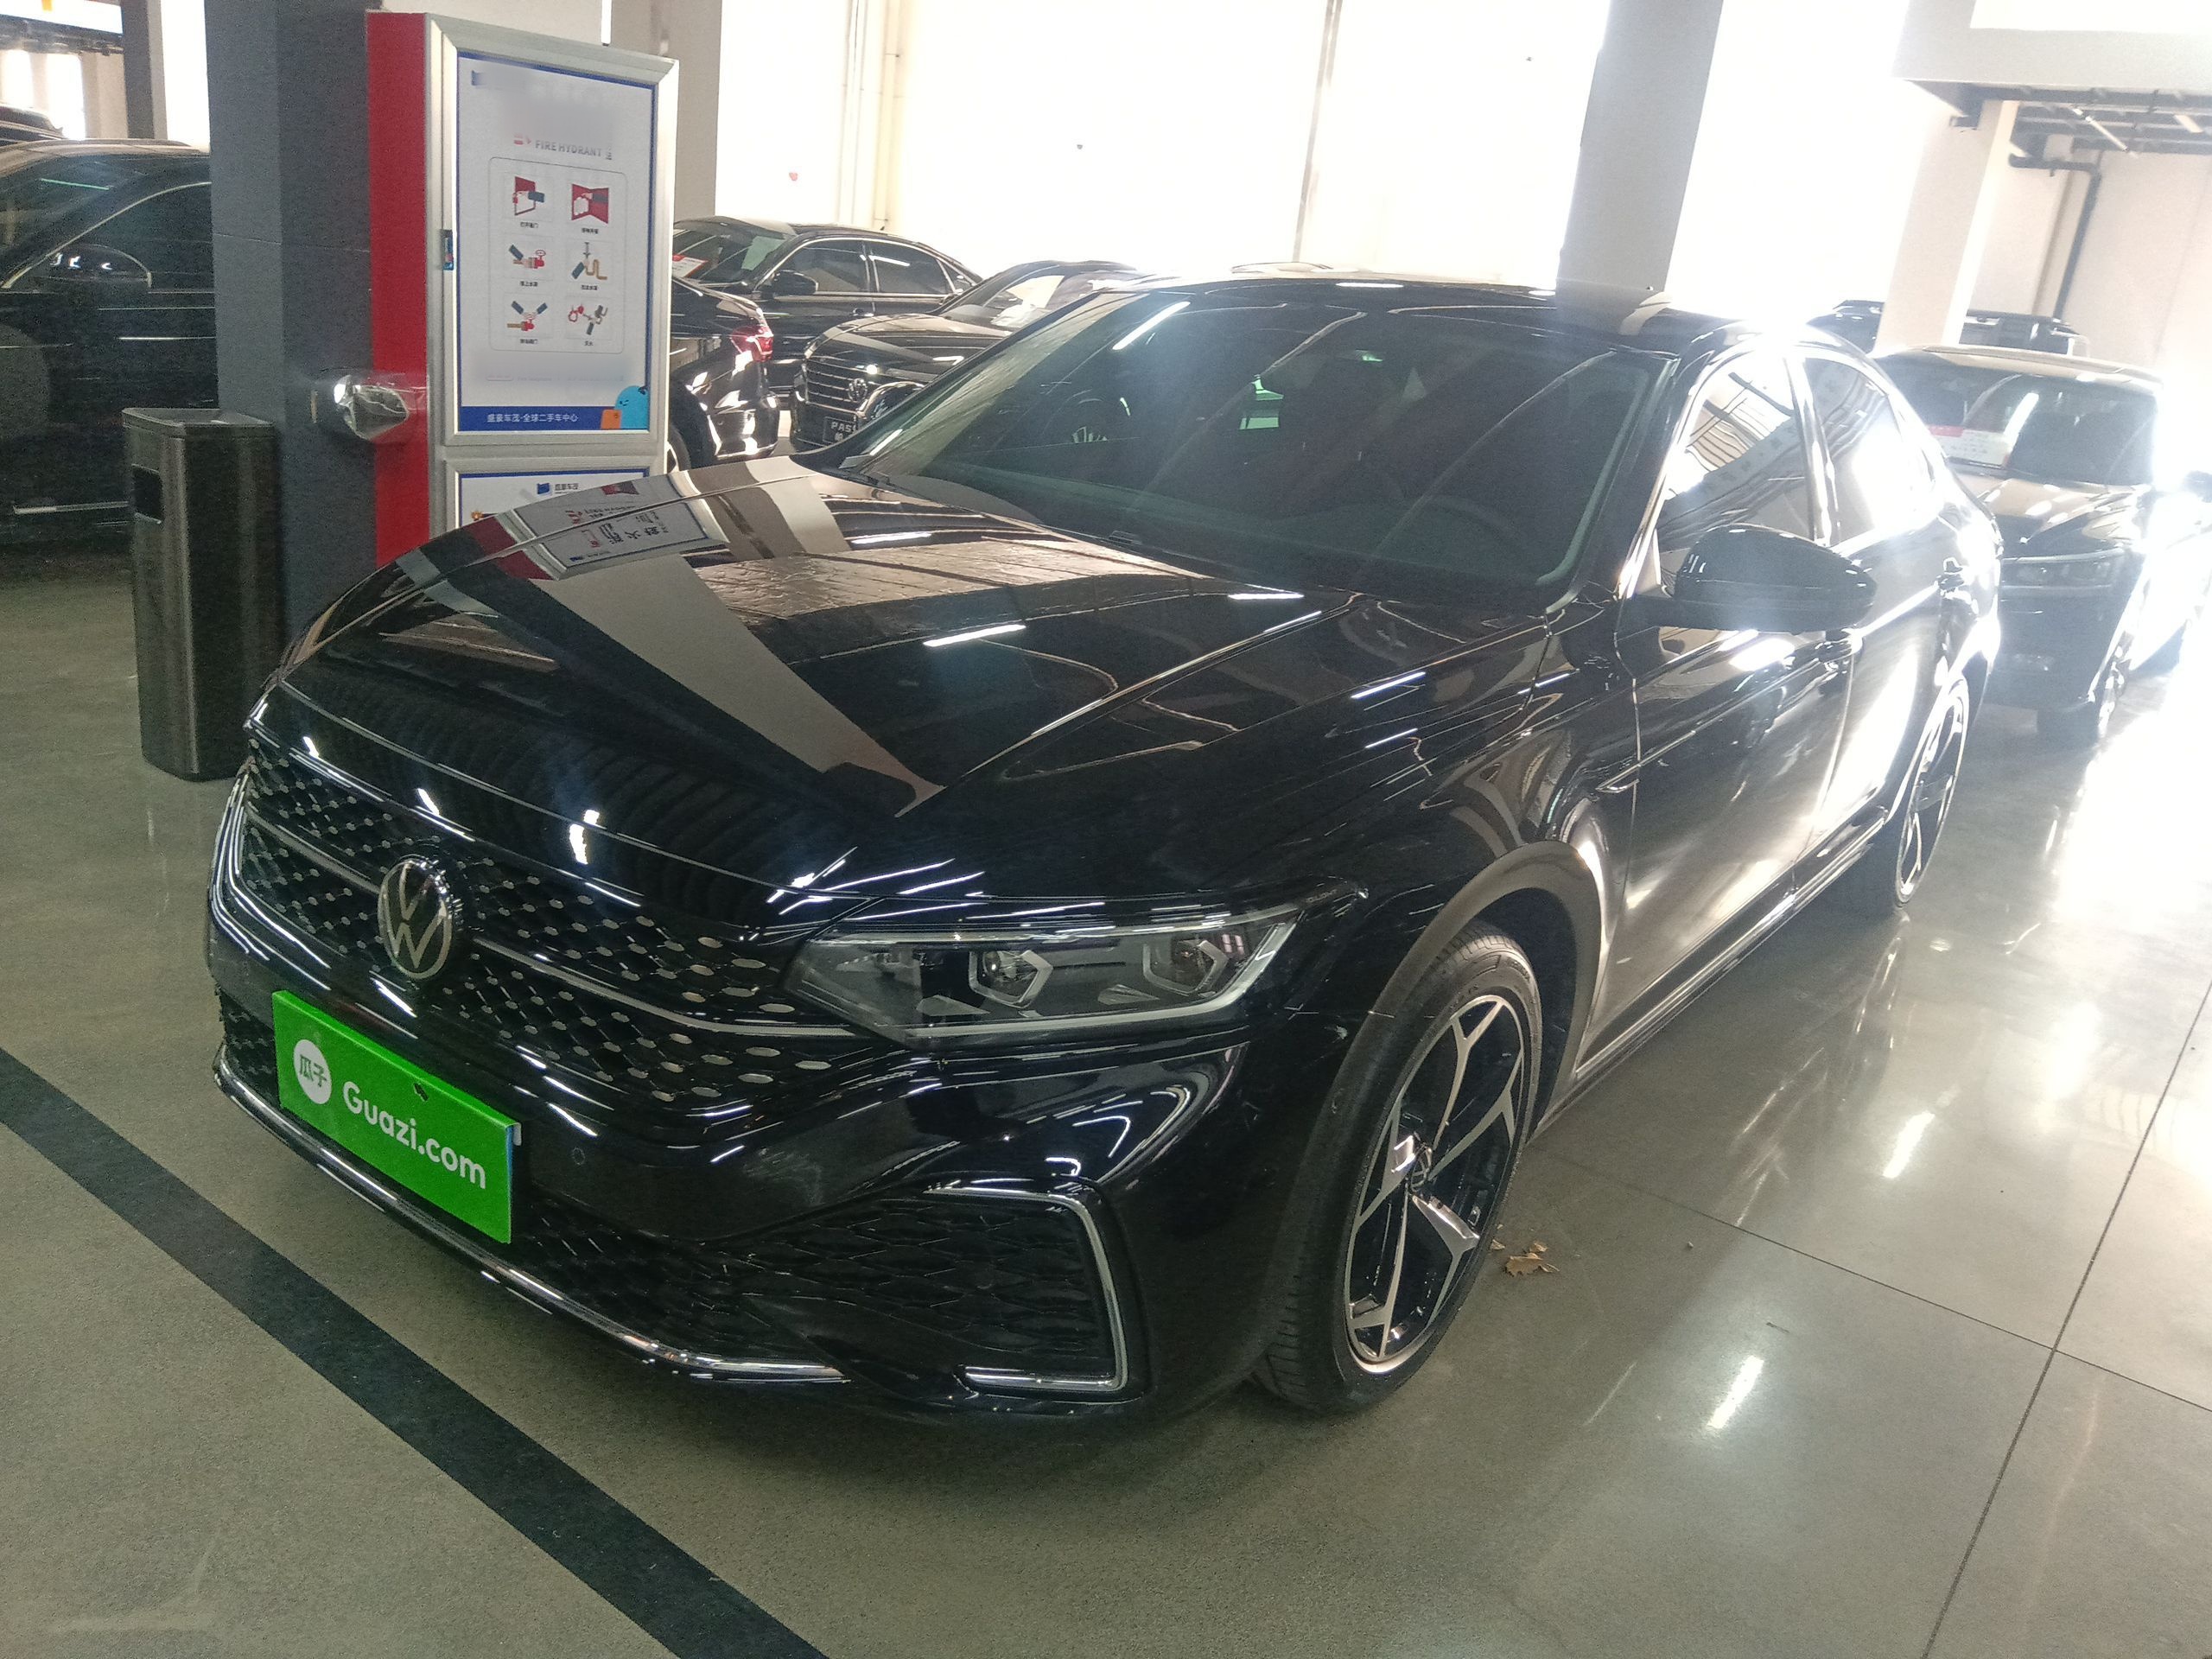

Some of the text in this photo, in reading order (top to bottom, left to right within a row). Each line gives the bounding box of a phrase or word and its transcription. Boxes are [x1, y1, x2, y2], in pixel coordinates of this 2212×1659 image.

[535, 139, 556, 151] FIRE
[558, 143, 602, 157] HYDRANT
[299, 1053, 327, 1089] 瓜子
[342, 1080, 486, 1190] Guazi.com
